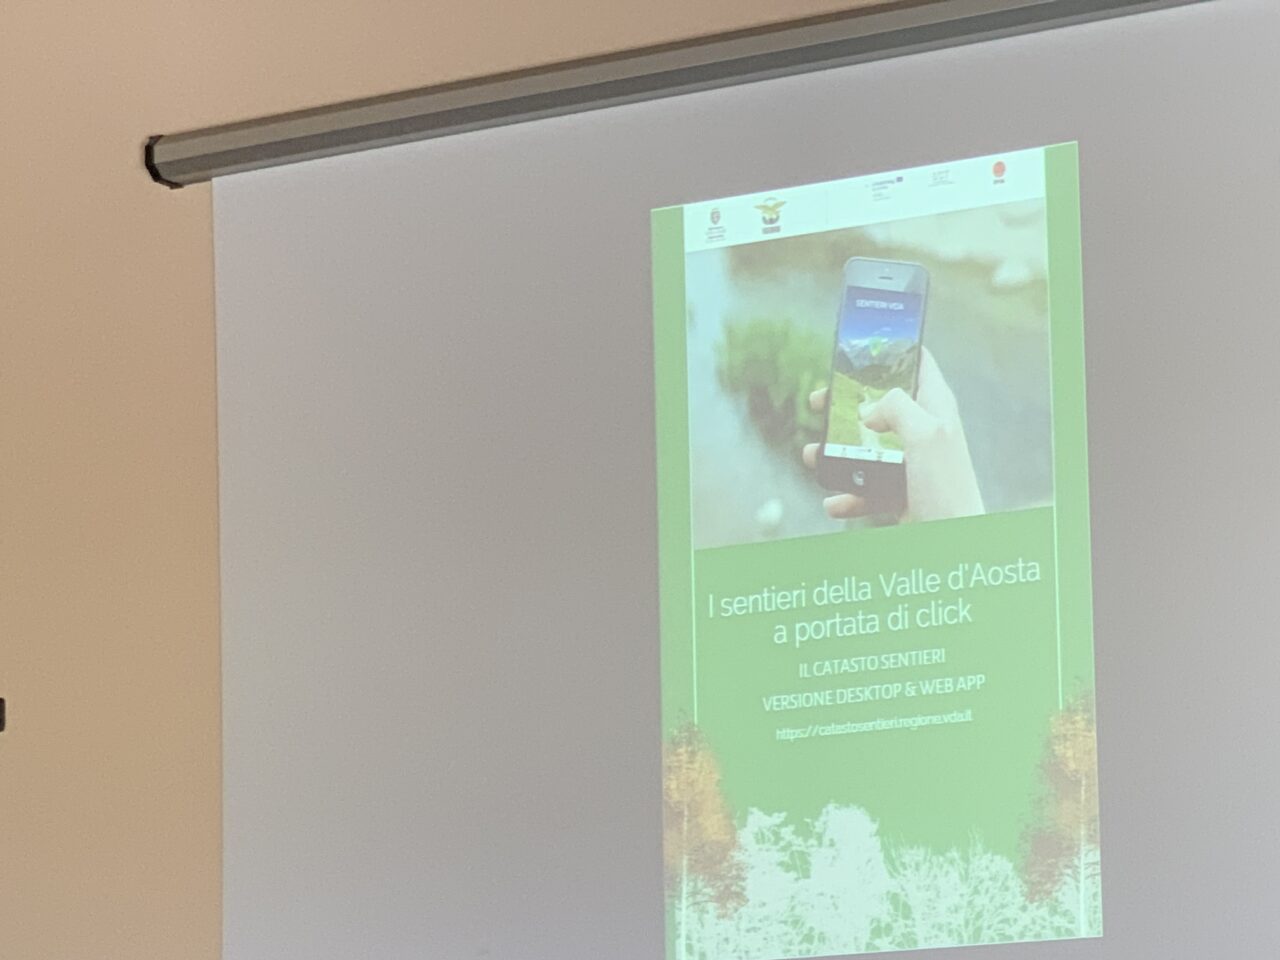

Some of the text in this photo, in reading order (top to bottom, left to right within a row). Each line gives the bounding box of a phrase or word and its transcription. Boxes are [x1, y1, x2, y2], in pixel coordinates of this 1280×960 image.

[709, 558, 1041, 618] I sentieri della Valle d'Aosta
[774, 598, 972, 648] a portata di click
[799, 648, 946, 678] IL CATASTO SENTIERI
[763, 674, 985, 711] VERSIONE DESKTOP & WEB APP
